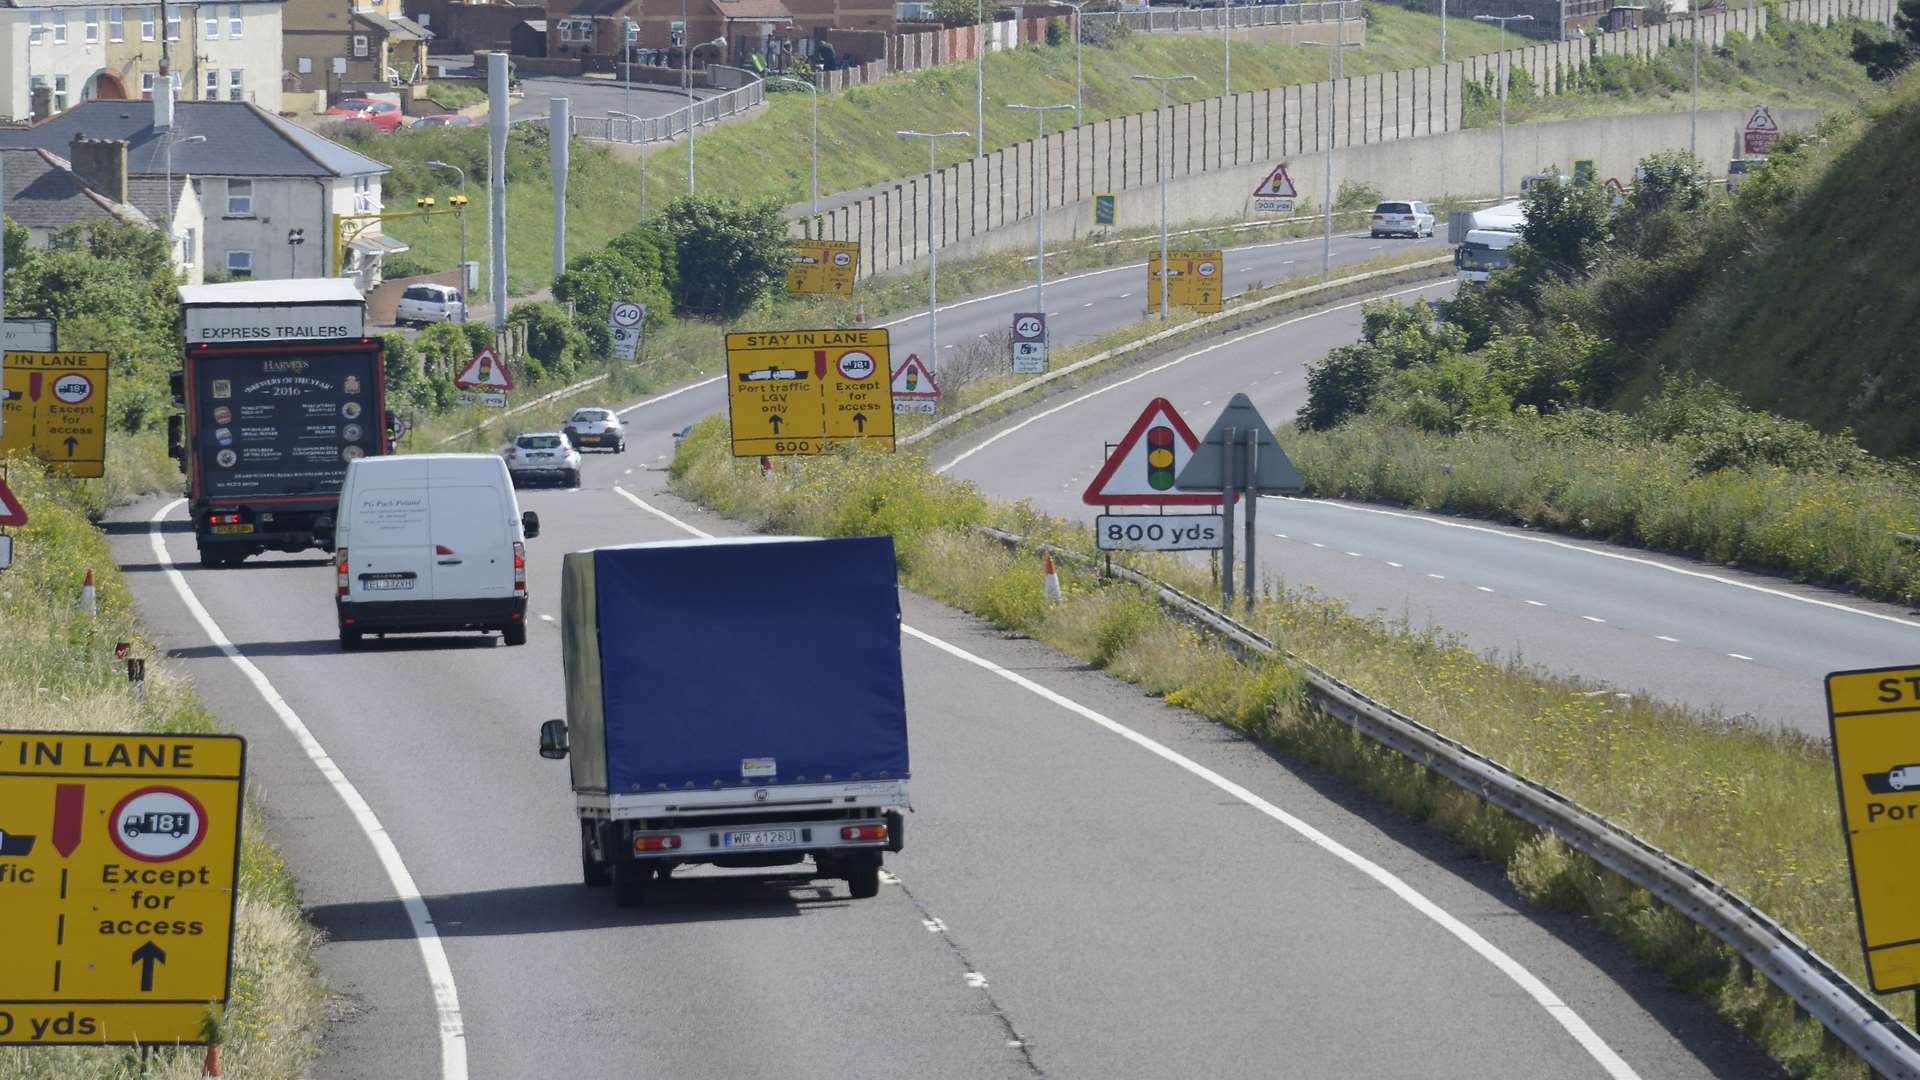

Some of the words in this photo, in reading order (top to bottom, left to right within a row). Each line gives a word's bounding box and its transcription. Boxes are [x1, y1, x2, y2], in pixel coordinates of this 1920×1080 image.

[616, 309, 638, 320] 40
[202, 327, 271, 338] EXPRESS
[275, 326, 348, 337] TRAILERS
[1018, 322, 1041, 333] 40
[747, 335, 790, 346] STAY
[797, 334, 815, 345] IN
[823, 333, 869, 344] LANE
[15, 355, 34, 366] IN
[41, 356, 88, 367] LANE
[273, 386, 301, 396] 2016
[738, 384, 766, 393] Port
[769, 382, 810, 392] traffic
[836, 382, 881, 393] Except
[761, 394, 788, 402] LGV
[849, 391, 868, 400] for
[49, 405, 96, 415] Except
[761, 404, 788, 414] only
[62, 415, 81, 425] for
[775, 442, 810, 452] 600
[1108, 524, 1164, 541] 800
[1170, 523, 1216, 544] yds
[19, 741, 63, 766] IN
[84, 743, 194, 768] LANE
[102, 864, 210, 887] Except
[130, 890, 175, 909] for
[98, 919, 204, 935] access
[30, 1011, 97, 1041] yds
